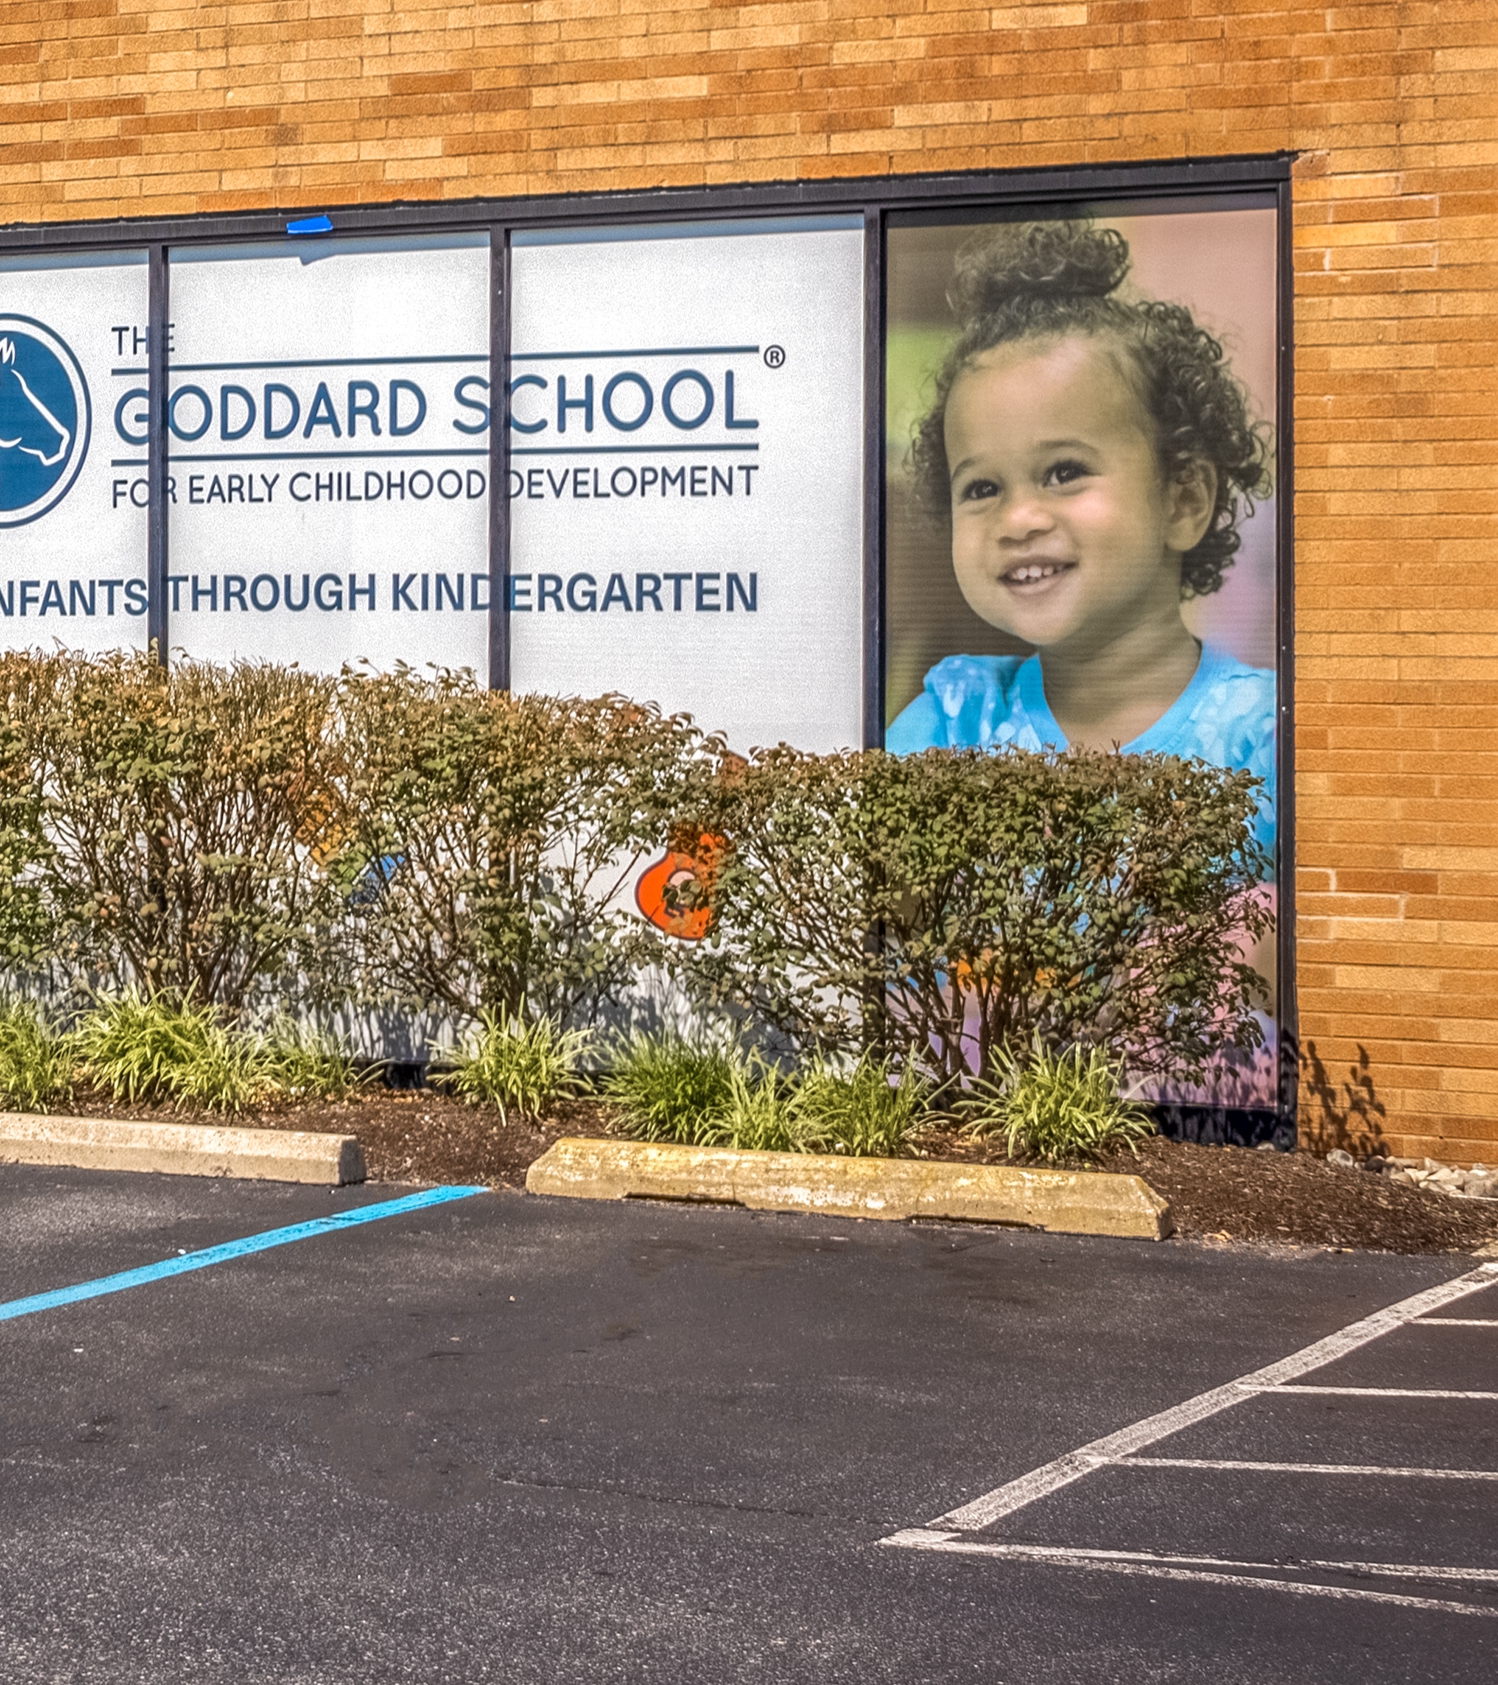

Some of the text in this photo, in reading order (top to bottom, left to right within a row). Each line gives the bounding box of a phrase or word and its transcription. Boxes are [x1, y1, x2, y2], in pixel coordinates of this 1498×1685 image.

[114, 379, 427, 446] GODDARD
[112, 465, 759, 509] FOR EARLY CHILDHOOD DEVELOPMENT
[166, 573, 376, 613] THROUGH
[391, 572, 758, 613] KINDERGARTEN
